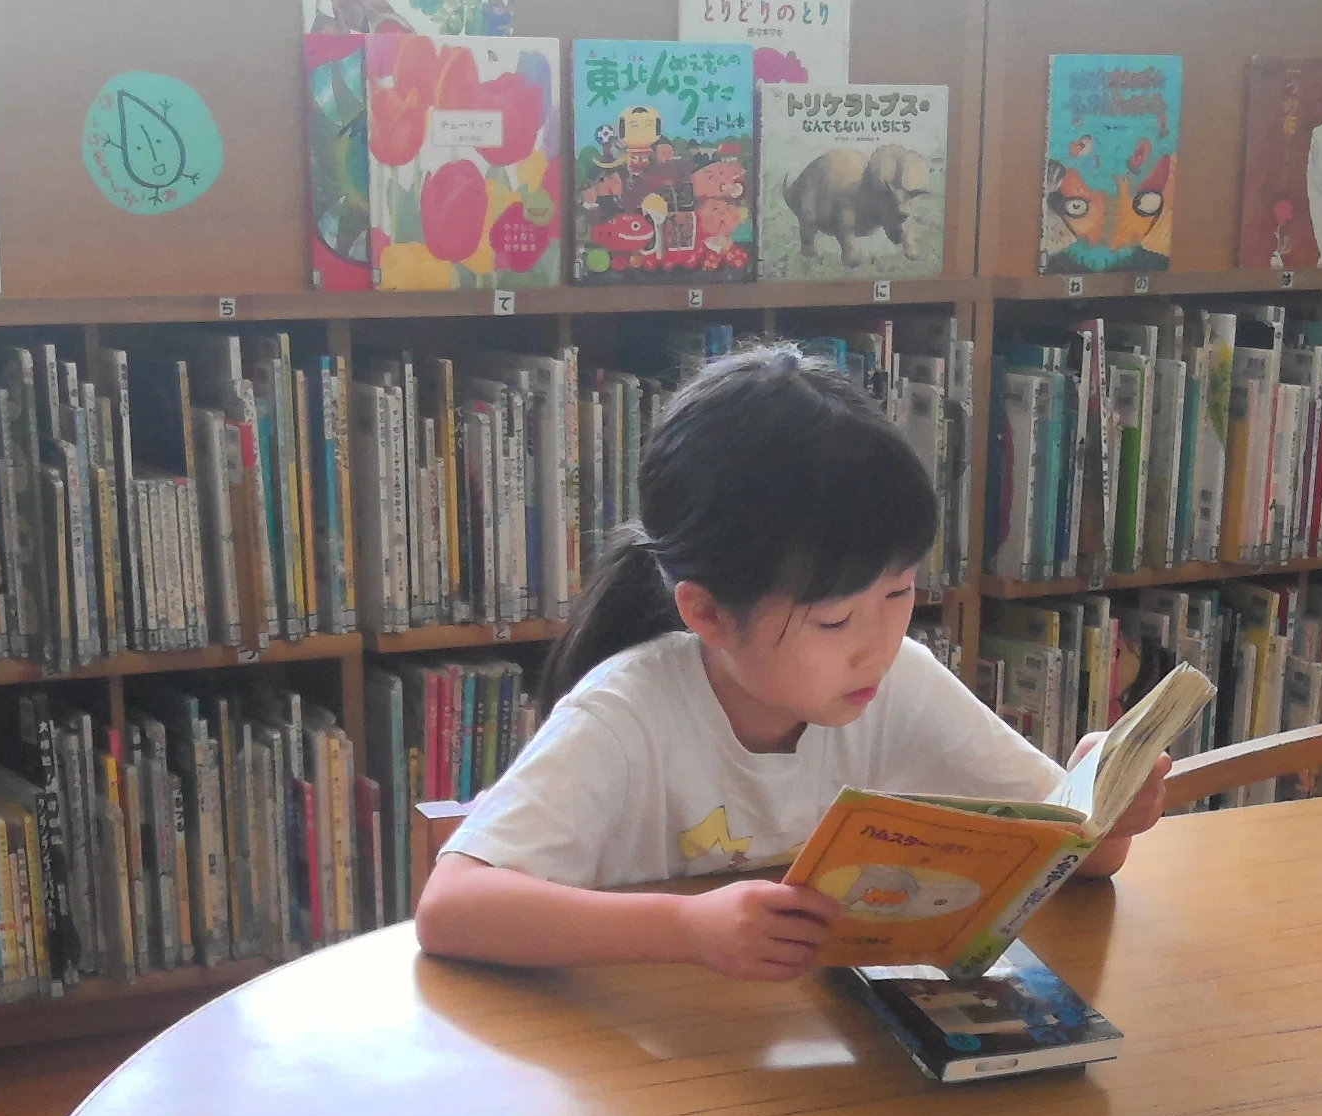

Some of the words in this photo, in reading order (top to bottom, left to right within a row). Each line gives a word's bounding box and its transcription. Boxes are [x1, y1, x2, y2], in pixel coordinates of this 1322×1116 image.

[802, 119, 865, 134] なんでもない
[871, 120, 912, 134] いちにち
[875, 282, 891, 299] に
